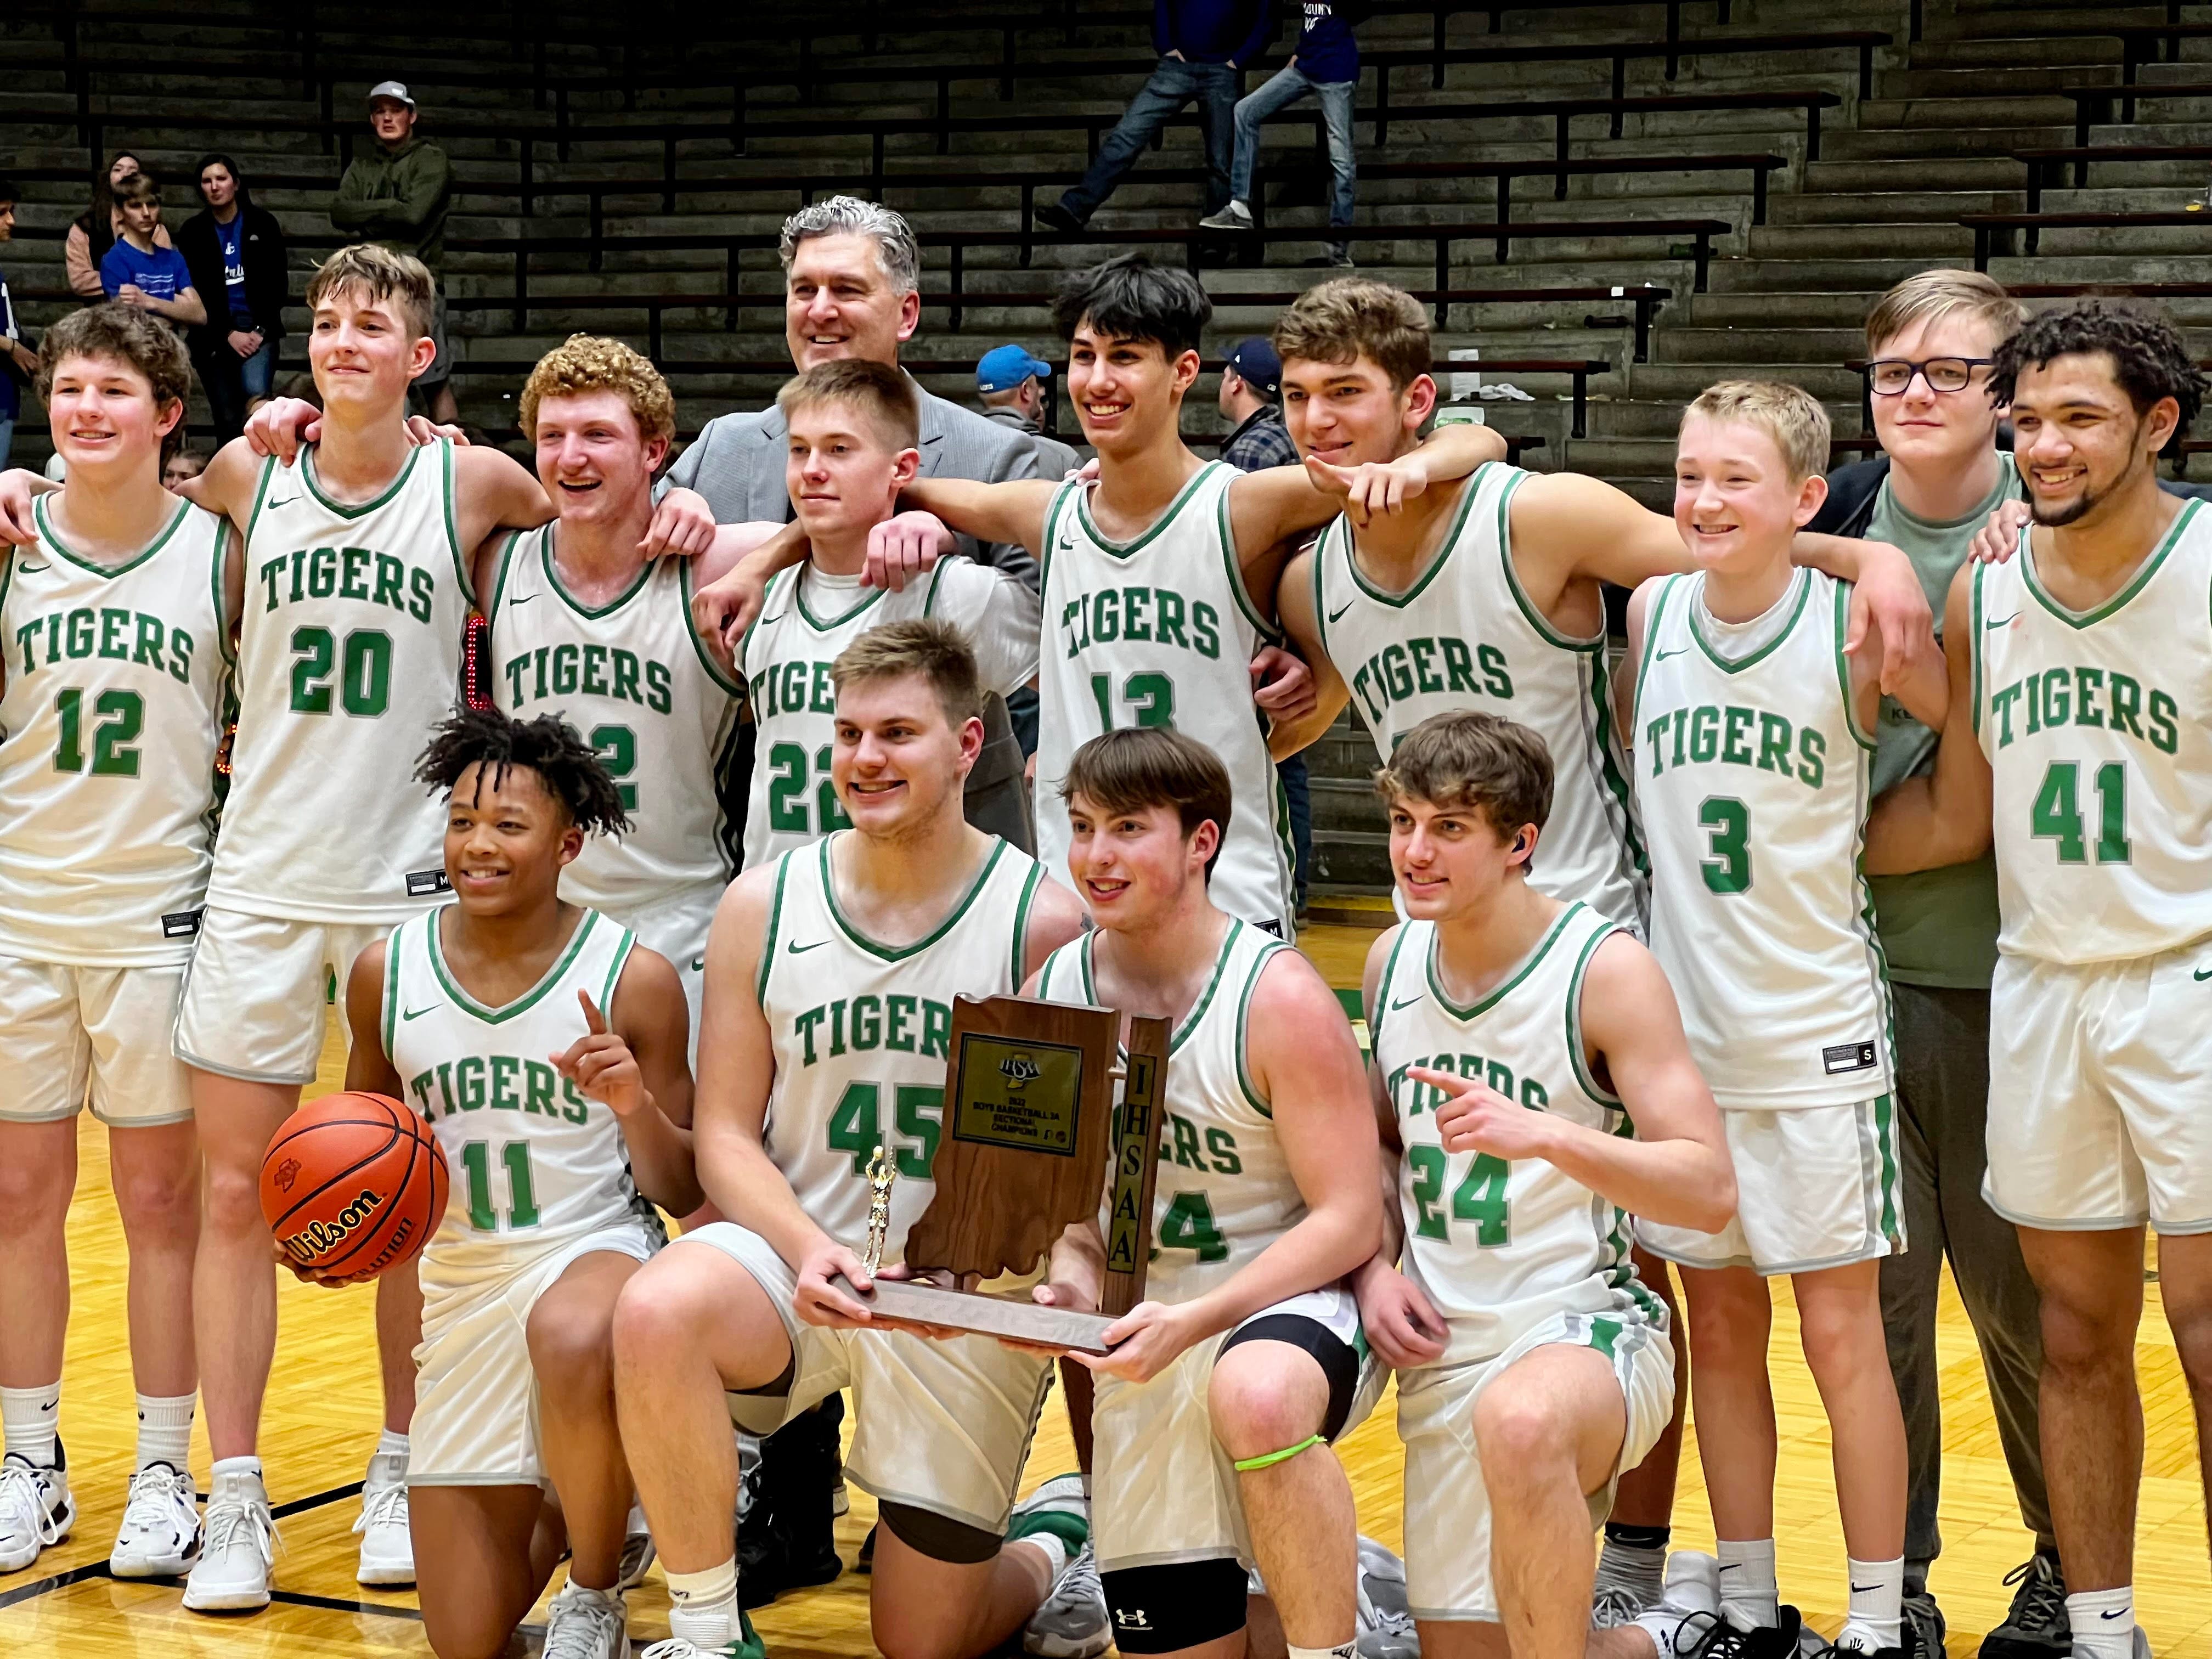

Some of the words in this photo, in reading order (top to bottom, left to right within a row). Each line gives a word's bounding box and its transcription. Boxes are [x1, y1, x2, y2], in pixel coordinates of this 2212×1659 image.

[261, 546, 435, 624] TIGERS
[1062, 586, 1221, 661] TIGERS
[16, 608, 194, 684] TIGERS
[289, 624, 394, 719] 20
[506, 643, 672, 715] TIGERS
[1352, 636, 1514, 727] TIGERS
[52, 686, 146, 780] 12
[749, 661, 834, 728] TIGE
[1991, 666, 2179, 756] TIGERS
[1646, 705, 1826, 791] TIGERS
[1697, 794, 1754, 896] 3
[2030, 759, 2132, 866] 41
[440, 876, 448, 885] M
[794, 994, 953, 1069] TIGER
[1864, 1049, 1872, 1060] S
[410, 1054, 589, 1126] TIGERS
[826, 1079, 946, 1181] 45
[973, 1101, 995, 1112] BOYS
[996, 1104, 1048, 1120] BASKETBALL
[460, 1139, 542, 1233] 11
[1110, 1063, 1150, 1263] IHSAA
[1408, 1141, 1512, 1250] 24
[284, 1189, 384, 1262] Wilson
